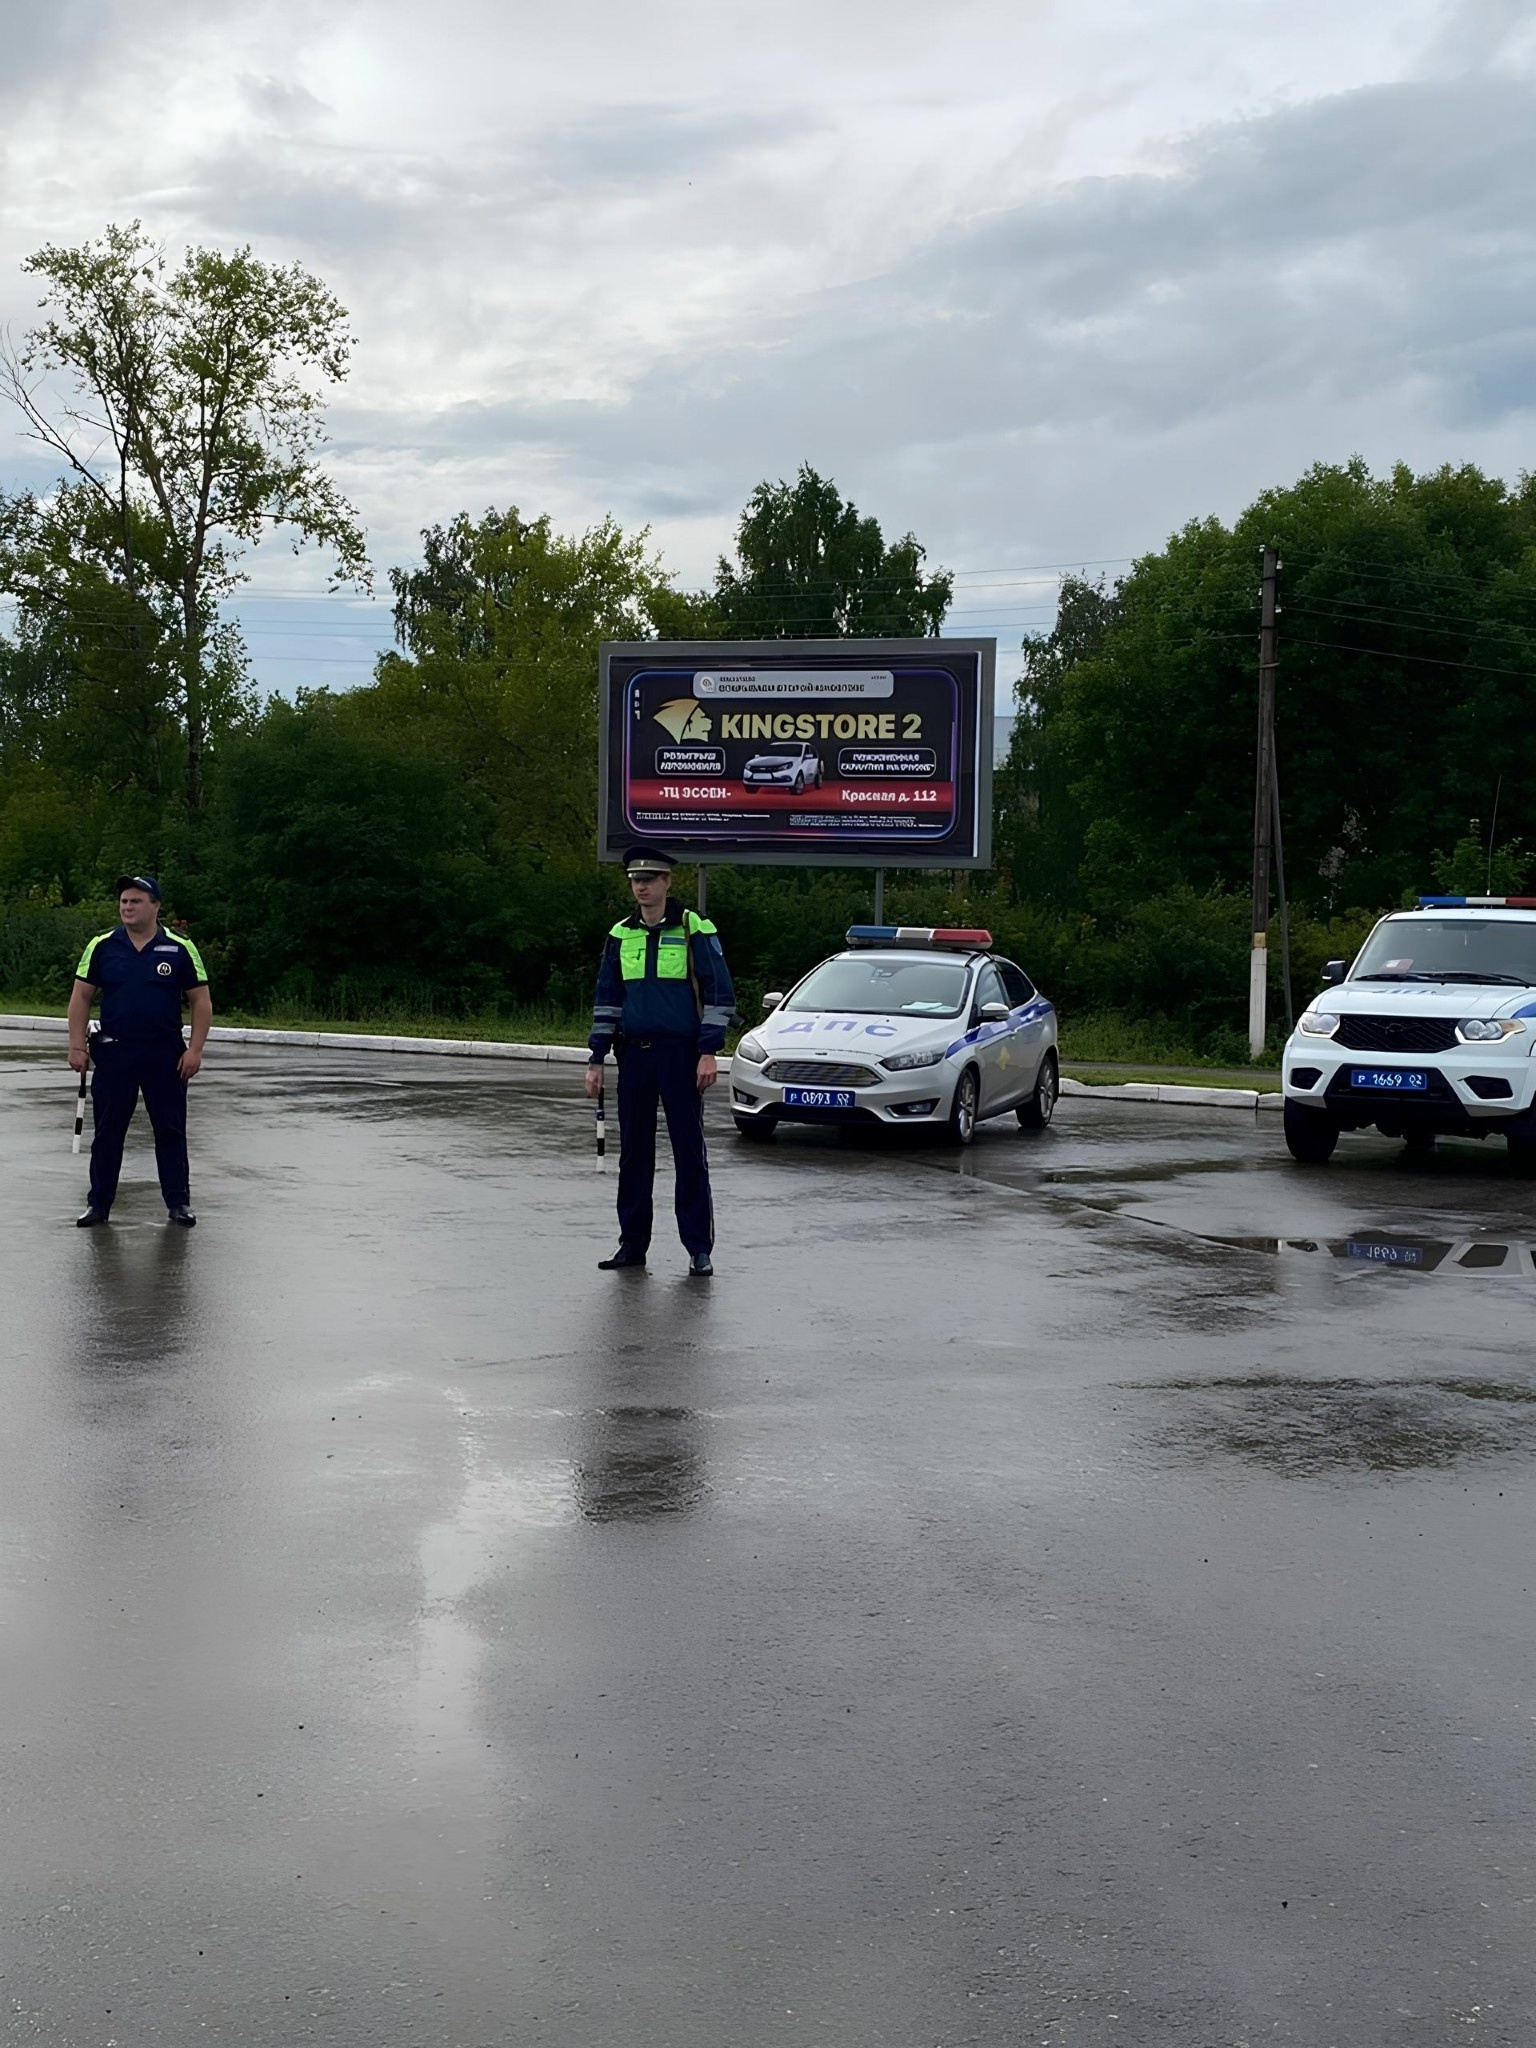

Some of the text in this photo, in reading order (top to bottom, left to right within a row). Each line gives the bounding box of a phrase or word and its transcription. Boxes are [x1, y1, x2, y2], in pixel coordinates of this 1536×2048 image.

[721, 713, 922, 740] KINGSTORE 2
[842, 789, 896, 803] Красная
[913, 790, 937, 801] 112
[778, 1020, 898, 1037] ДПС
